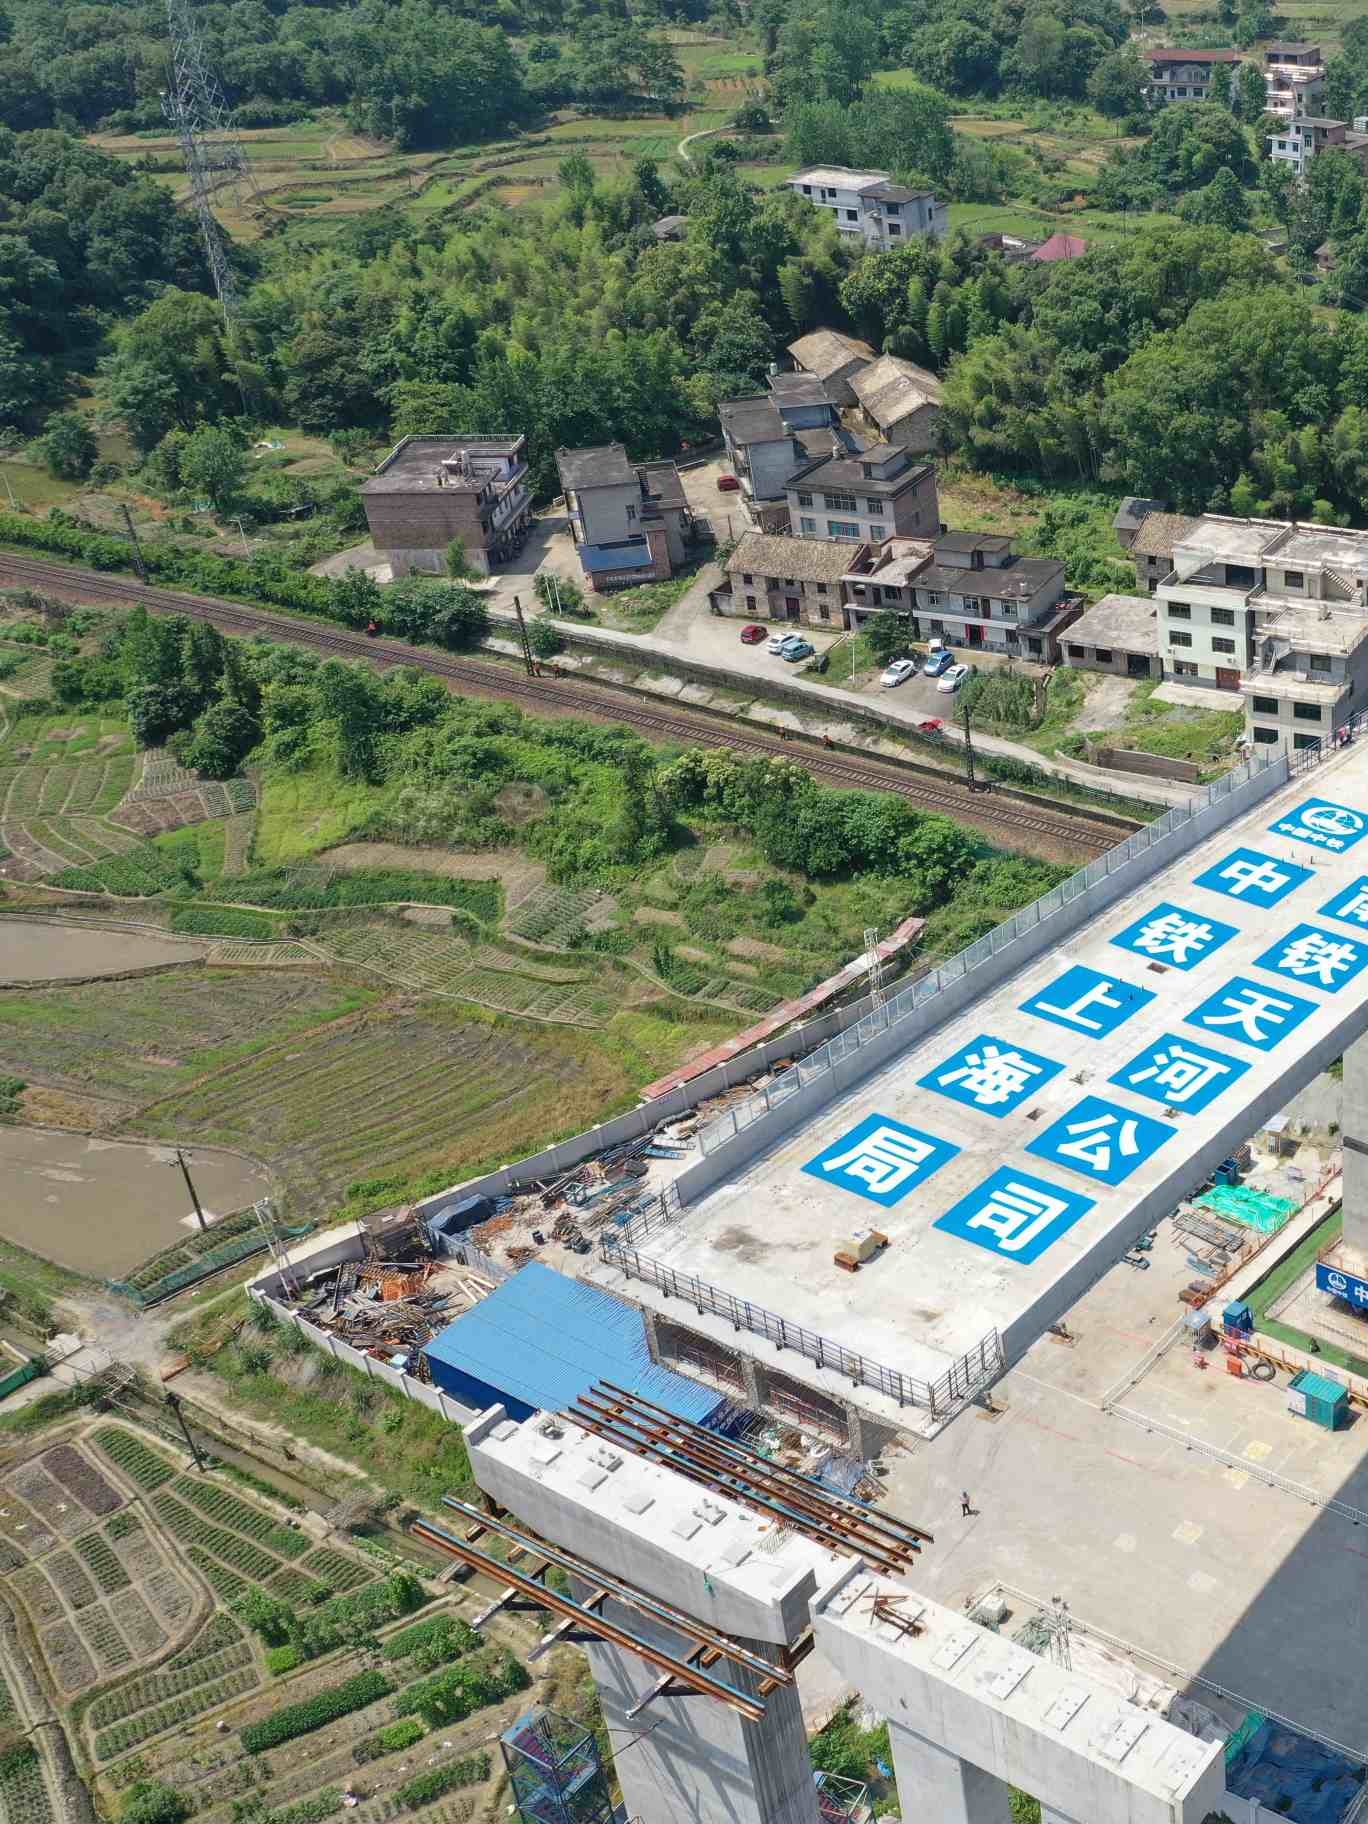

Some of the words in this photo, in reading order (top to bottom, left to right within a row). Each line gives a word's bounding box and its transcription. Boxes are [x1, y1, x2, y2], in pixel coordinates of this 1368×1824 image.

[821, 856, 1292, 1196] 中铁上海局
